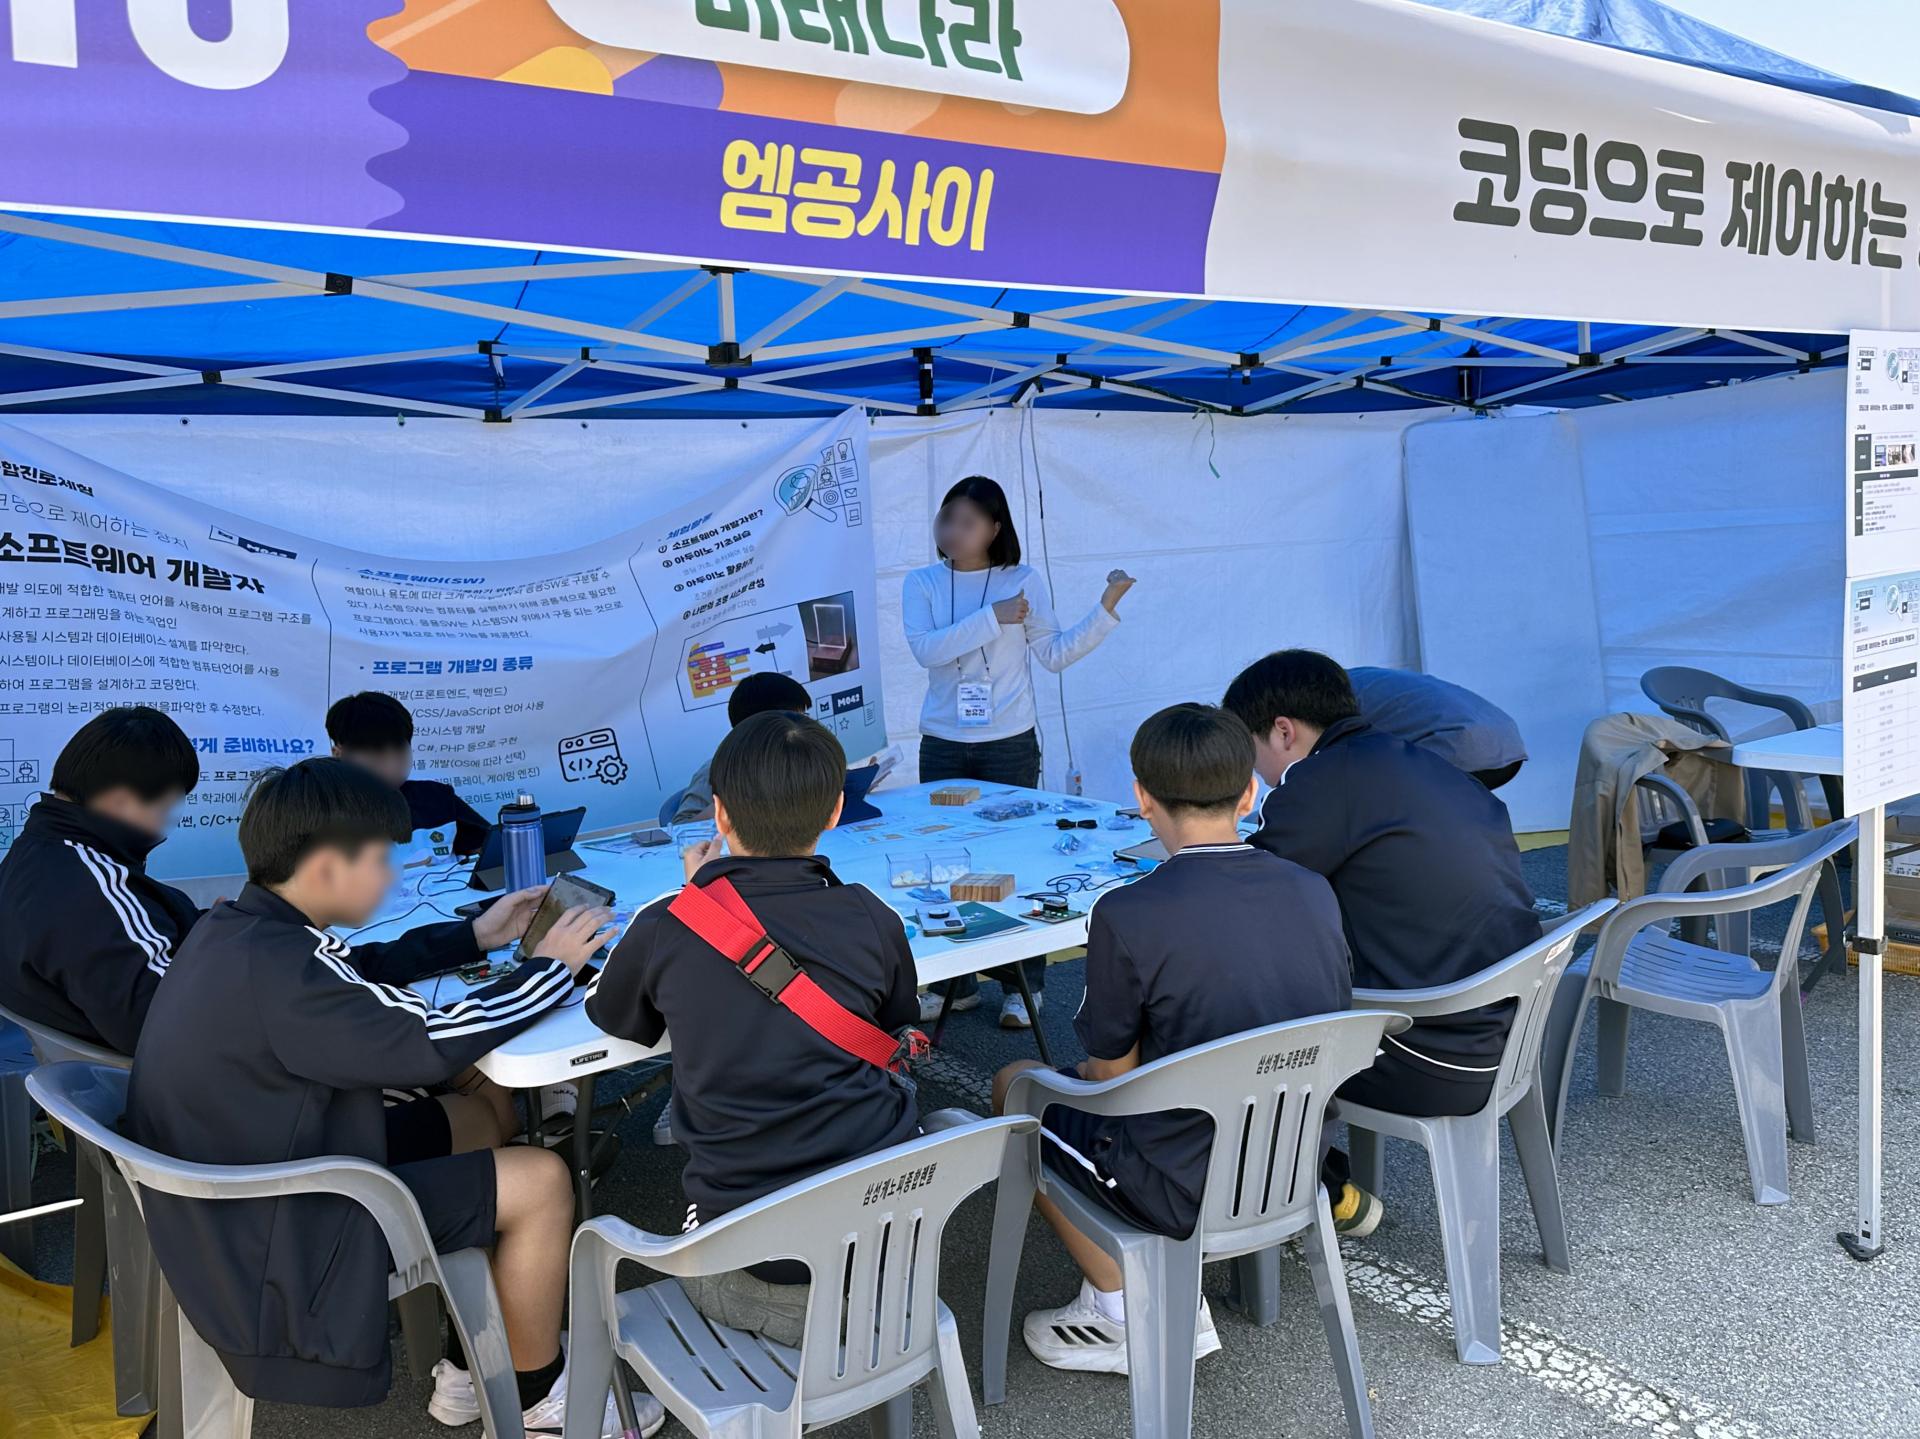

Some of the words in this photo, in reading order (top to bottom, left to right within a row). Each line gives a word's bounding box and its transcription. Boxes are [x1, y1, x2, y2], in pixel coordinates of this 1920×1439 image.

[720, 139, 994, 251] 엠공사이
[1453, 117, 1705, 247] 코딩으로
[1720, 161, 1907, 269] 제어하는
[70, 510, 149, 539] 제어하는
[0, 532, 157, 580] 소프트웨어
[167, 558, 265, 594] 개발자
[674, 548, 714, 564] 아두이노
[686, 571, 725, 588] 아두이노
[421, 591, 441, 600] 따라
[24, 583, 62, 596] 의도에
[67, 584, 104, 597] 적합한
[139, 594, 175, 608] 언어를
[179, 599, 223, 616] 사용하여
[227, 607, 273, 622] 프로그램
[276, 612, 313, 625] 구조를
[45, 607, 121, 621] 프로그래밍을
[0, 630, 37, 644] 사용될
[42, 631, 93, 643] 시스템과
[97, 631, 167, 646] 데이터베이스
[201, 641, 249, 656] 파악한다.
[0, 654, 63, 667] 시스템이나
[67, 655, 155, 667] 데이터베이스에
[159, 656, 190, 670] 적합한
[257, 665, 280, 677] 사용
[372, 661, 442, 675] 프로그램
[448, 658, 497, 674] 개발의
[502, 656, 534, 672] 종류
[0, 679, 24, 691] 하여
[29, 679, 93, 690] 프로그램을
[97, 678, 147, 690] 설계하고
[150, 678, 199, 692] 코딩한다.
[473, 686, 508, 699] 백엔드)
[0, 701, 63, 715] 프로그램의
[209, 703, 219, 714] 후
[222, 704, 264, 717] 수정한다.
[503, 704, 523, 715] 언어
[525, 701, 545, 711] 사용
[466, 724, 486, 735] 개발
[224, 737, 314, 753] 준비하나요?
[440, 744, 464, 752] PHP
[200, 814, 242, 827] C/C++
[574, 1053, 604, 1065] LIFETIME
